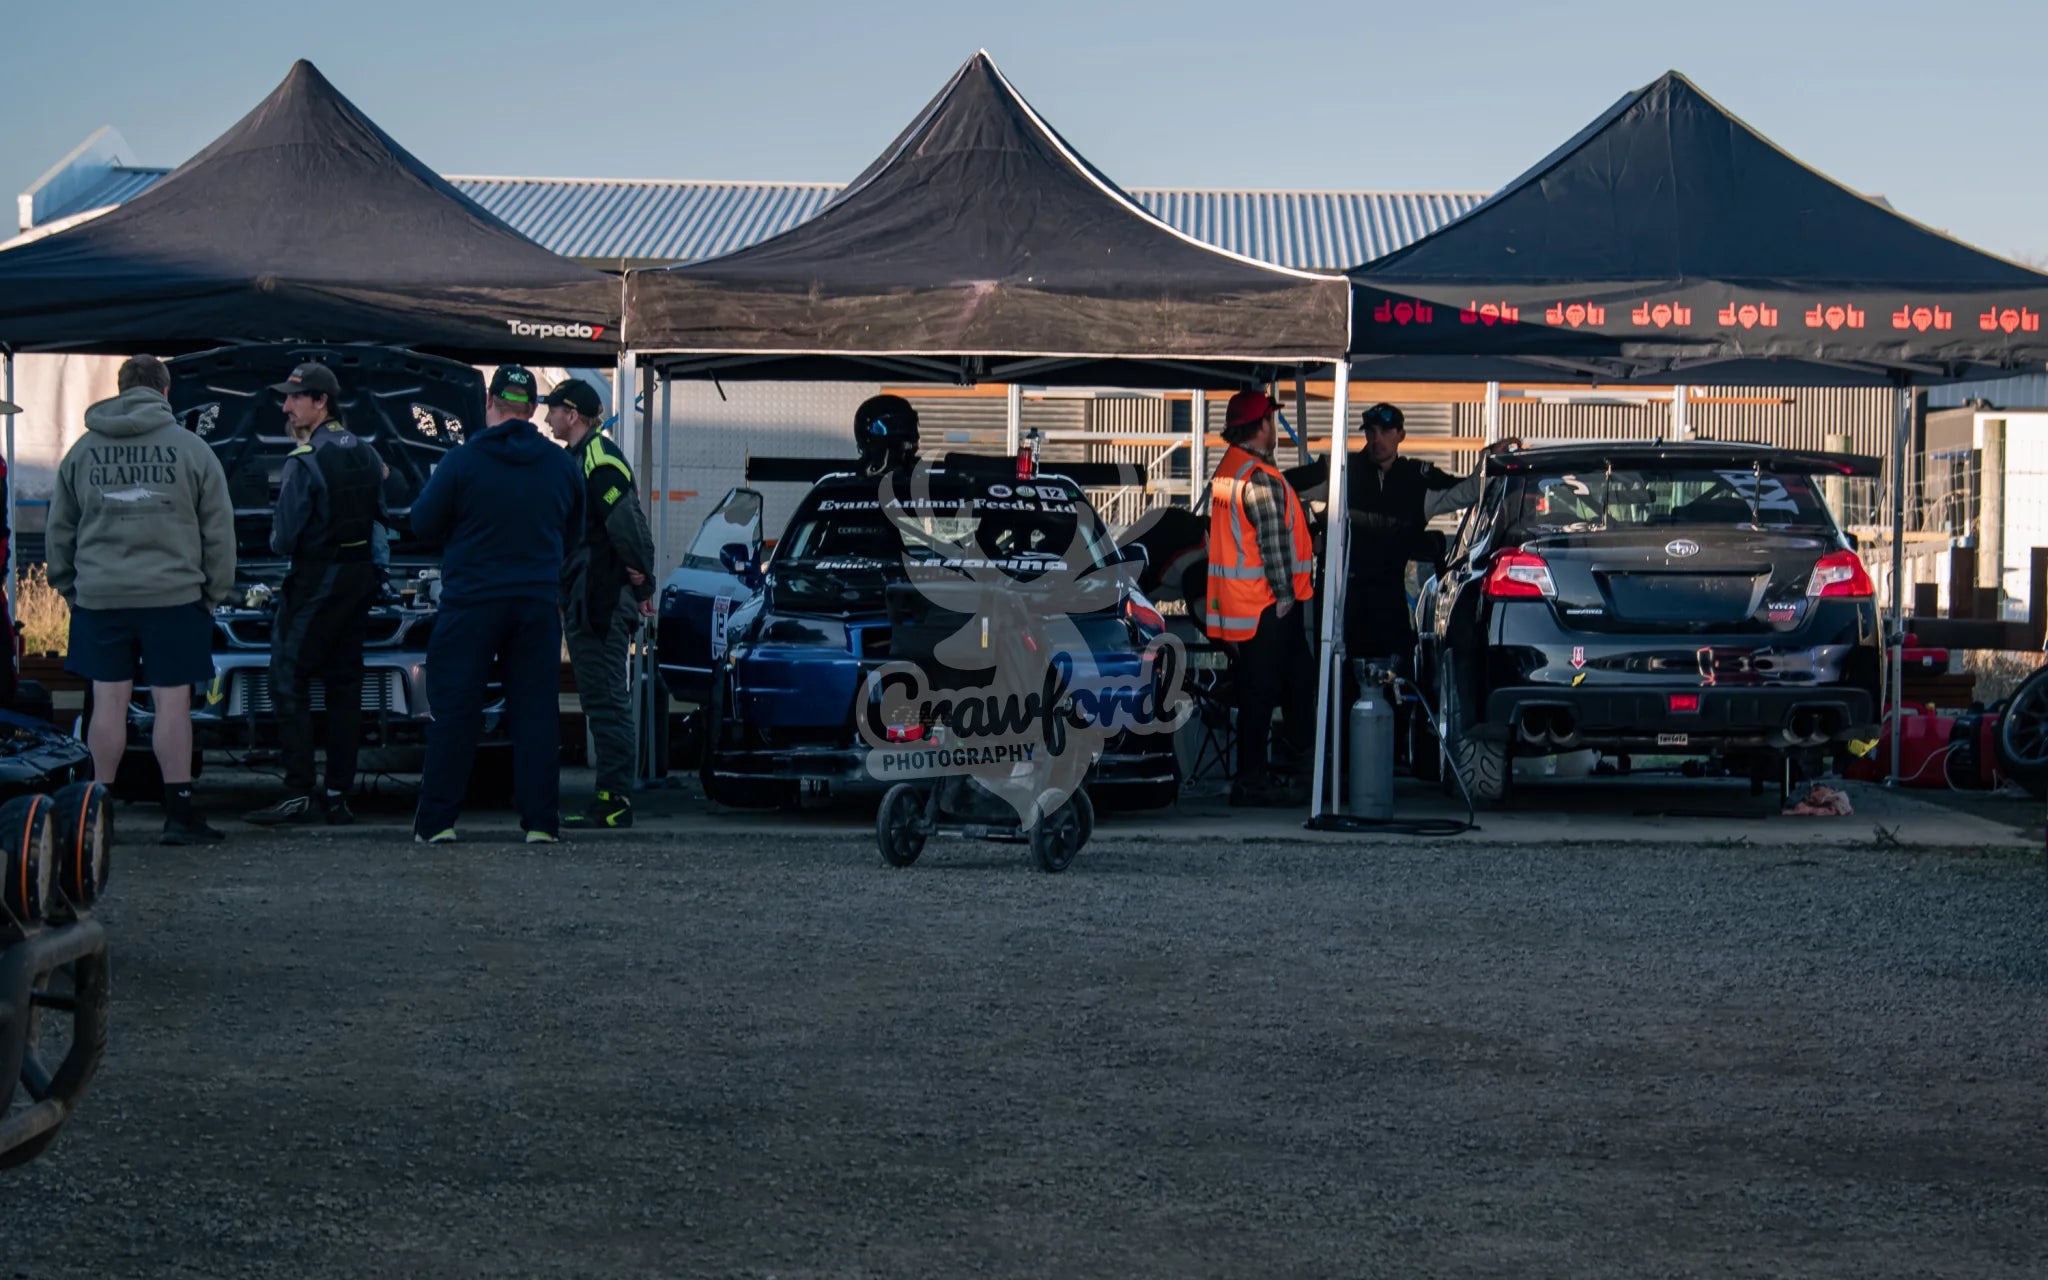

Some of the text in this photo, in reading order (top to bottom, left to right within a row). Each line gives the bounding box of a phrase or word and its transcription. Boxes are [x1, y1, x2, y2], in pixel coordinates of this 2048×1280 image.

[507, 320, 605, 341] Torpedo7
[89, 445, 177, 465] XIPHIAS
[89, 465, 176, 487] GLADIUS
[817, 497, 1078, 514] Evans Animal Feeds Ltd
[715, 611, 725, 638] 12
